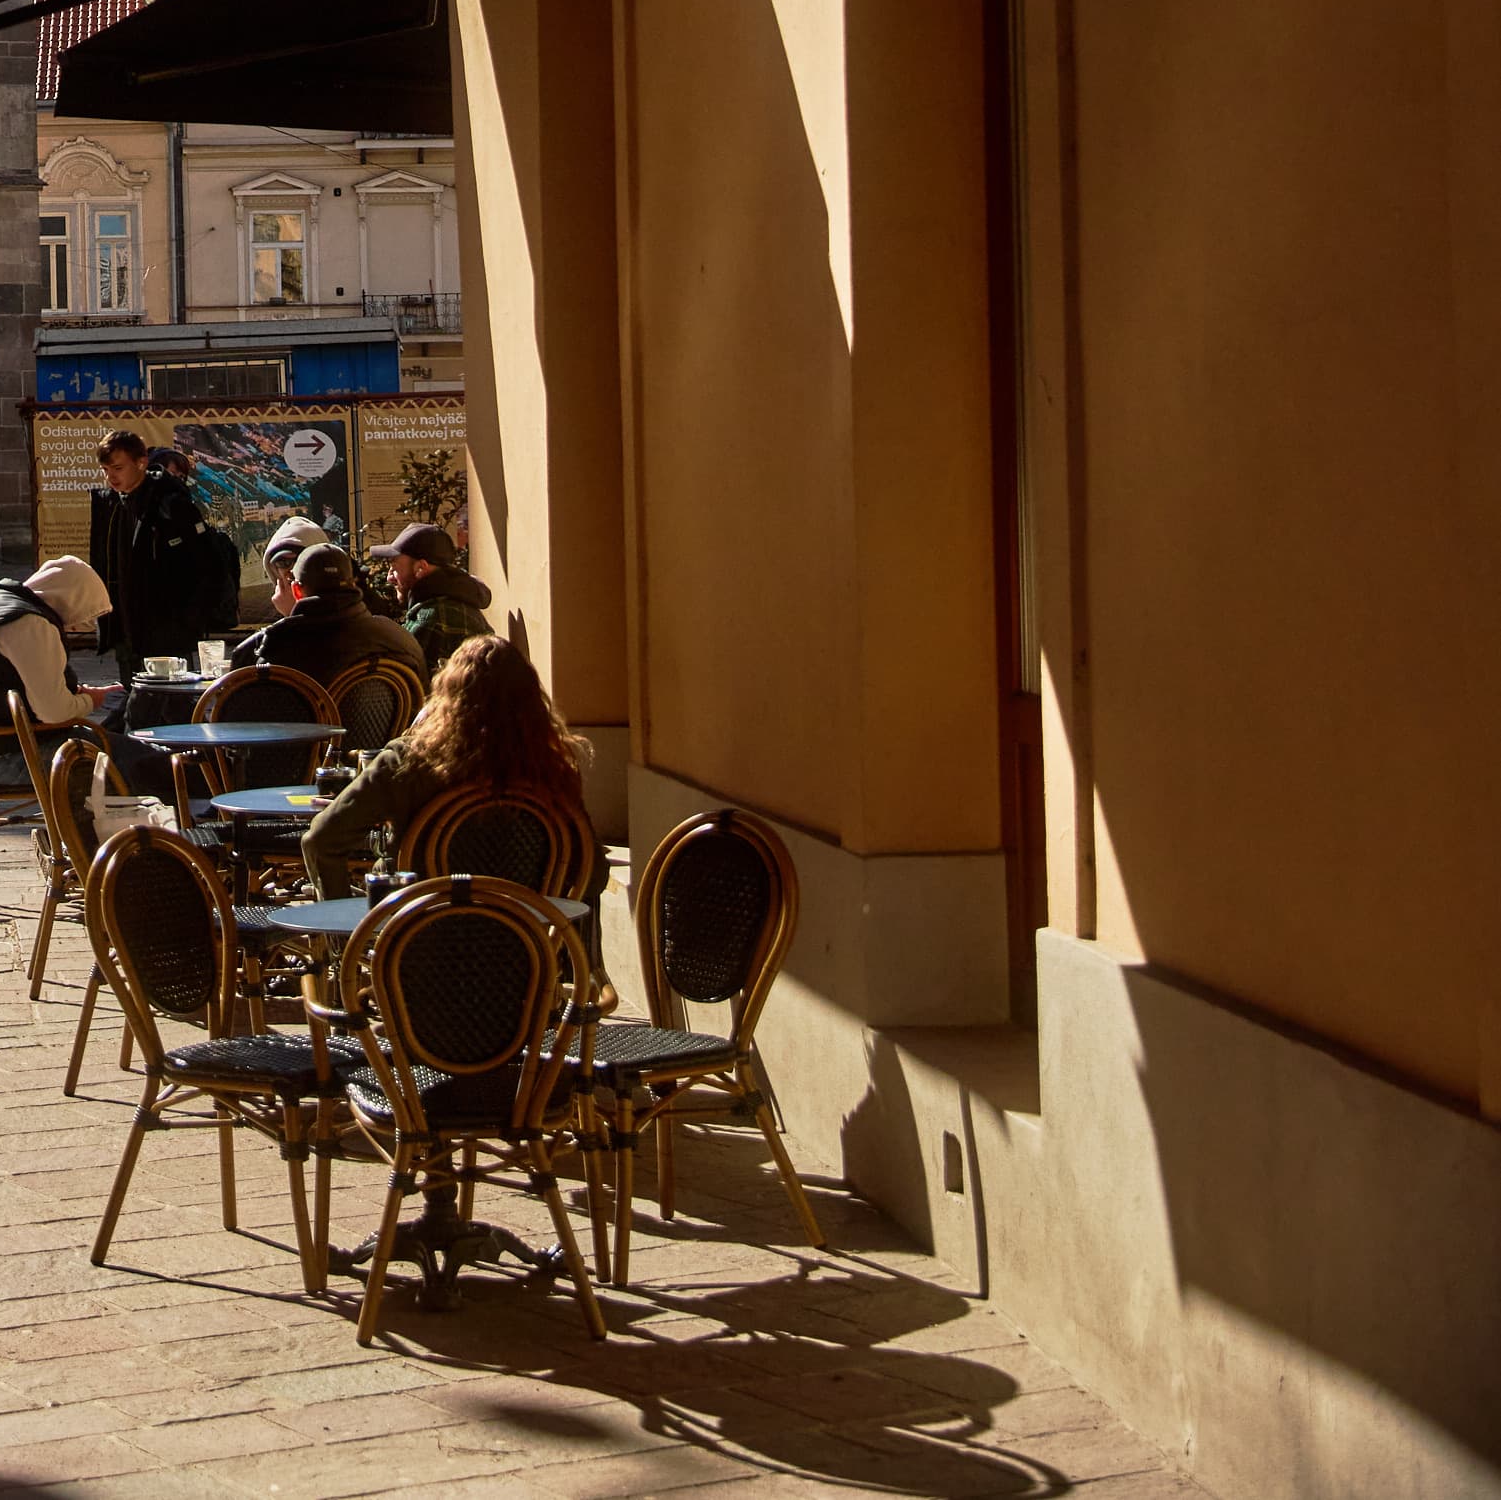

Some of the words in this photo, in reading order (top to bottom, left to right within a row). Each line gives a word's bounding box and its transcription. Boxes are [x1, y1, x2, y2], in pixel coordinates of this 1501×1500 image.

[409, 416, 418, 425] v
[364, 426, 448, 442] pamiatkovej
[41, 440, 75, 453] svoju
[41, 456, 49, 464] v
[52, 452, 93, 466] živých
